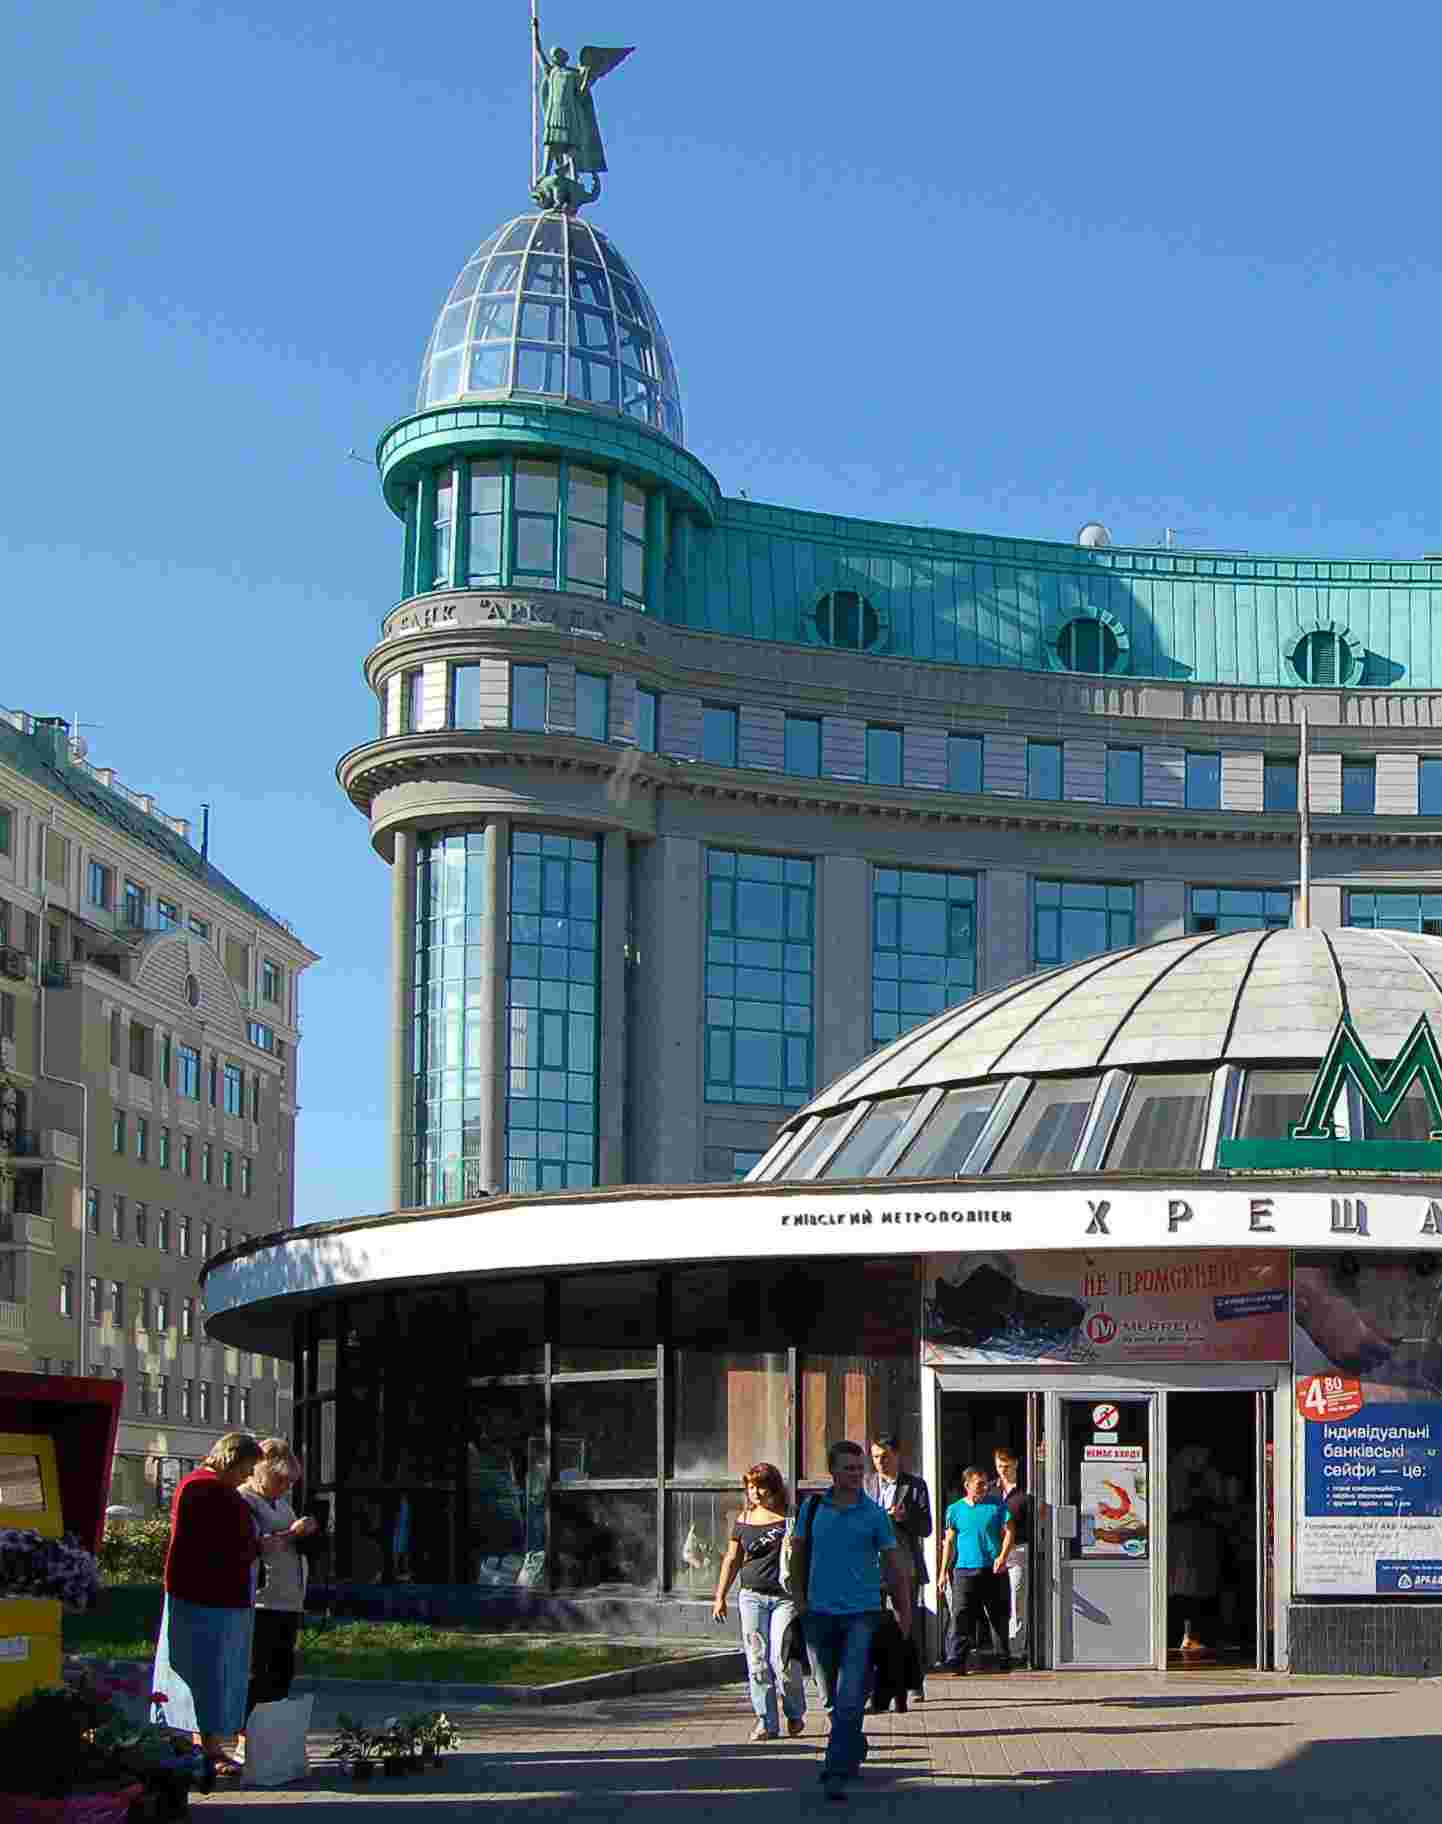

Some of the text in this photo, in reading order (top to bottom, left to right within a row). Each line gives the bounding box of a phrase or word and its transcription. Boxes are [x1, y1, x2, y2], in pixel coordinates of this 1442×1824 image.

[1323, 1423, 1430, 1442] Індивідуальні
[1323, 1443, 1405, 1459] банківські
[1323, 1463, 1376, 1479] сейфи
[1403, 1465, 1426, 1479] це:
